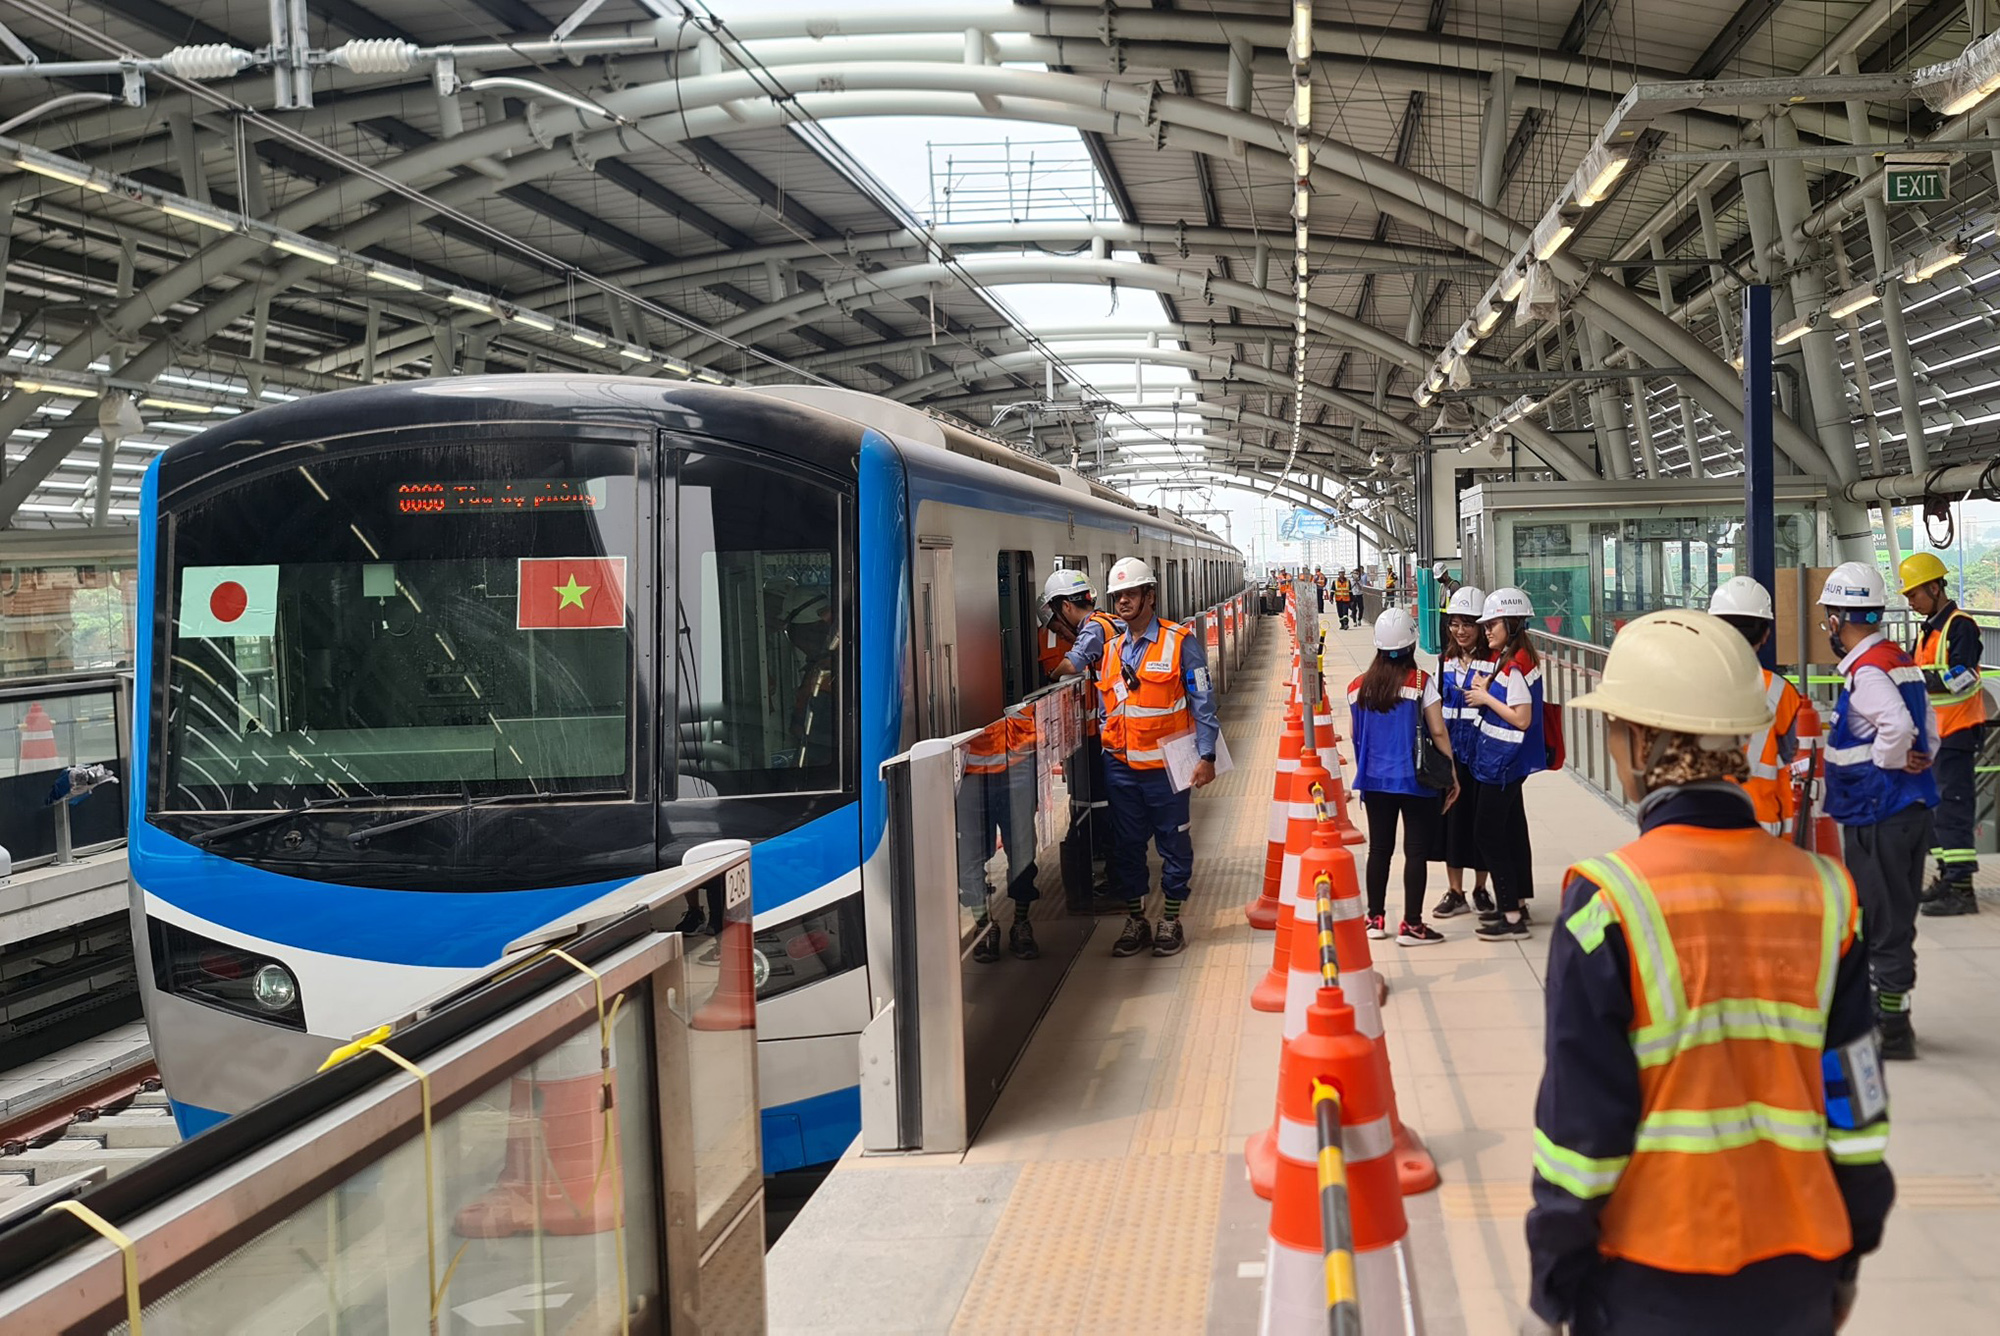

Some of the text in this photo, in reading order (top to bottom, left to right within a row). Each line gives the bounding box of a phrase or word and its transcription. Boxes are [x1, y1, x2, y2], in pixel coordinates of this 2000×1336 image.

[1896, 174, 1938, 197] EXIT
[1823, 583, 1843, 596] AUR
[1500, 598, 1523, 606] MAUR
[729, 868, 747, 903] 2-08
